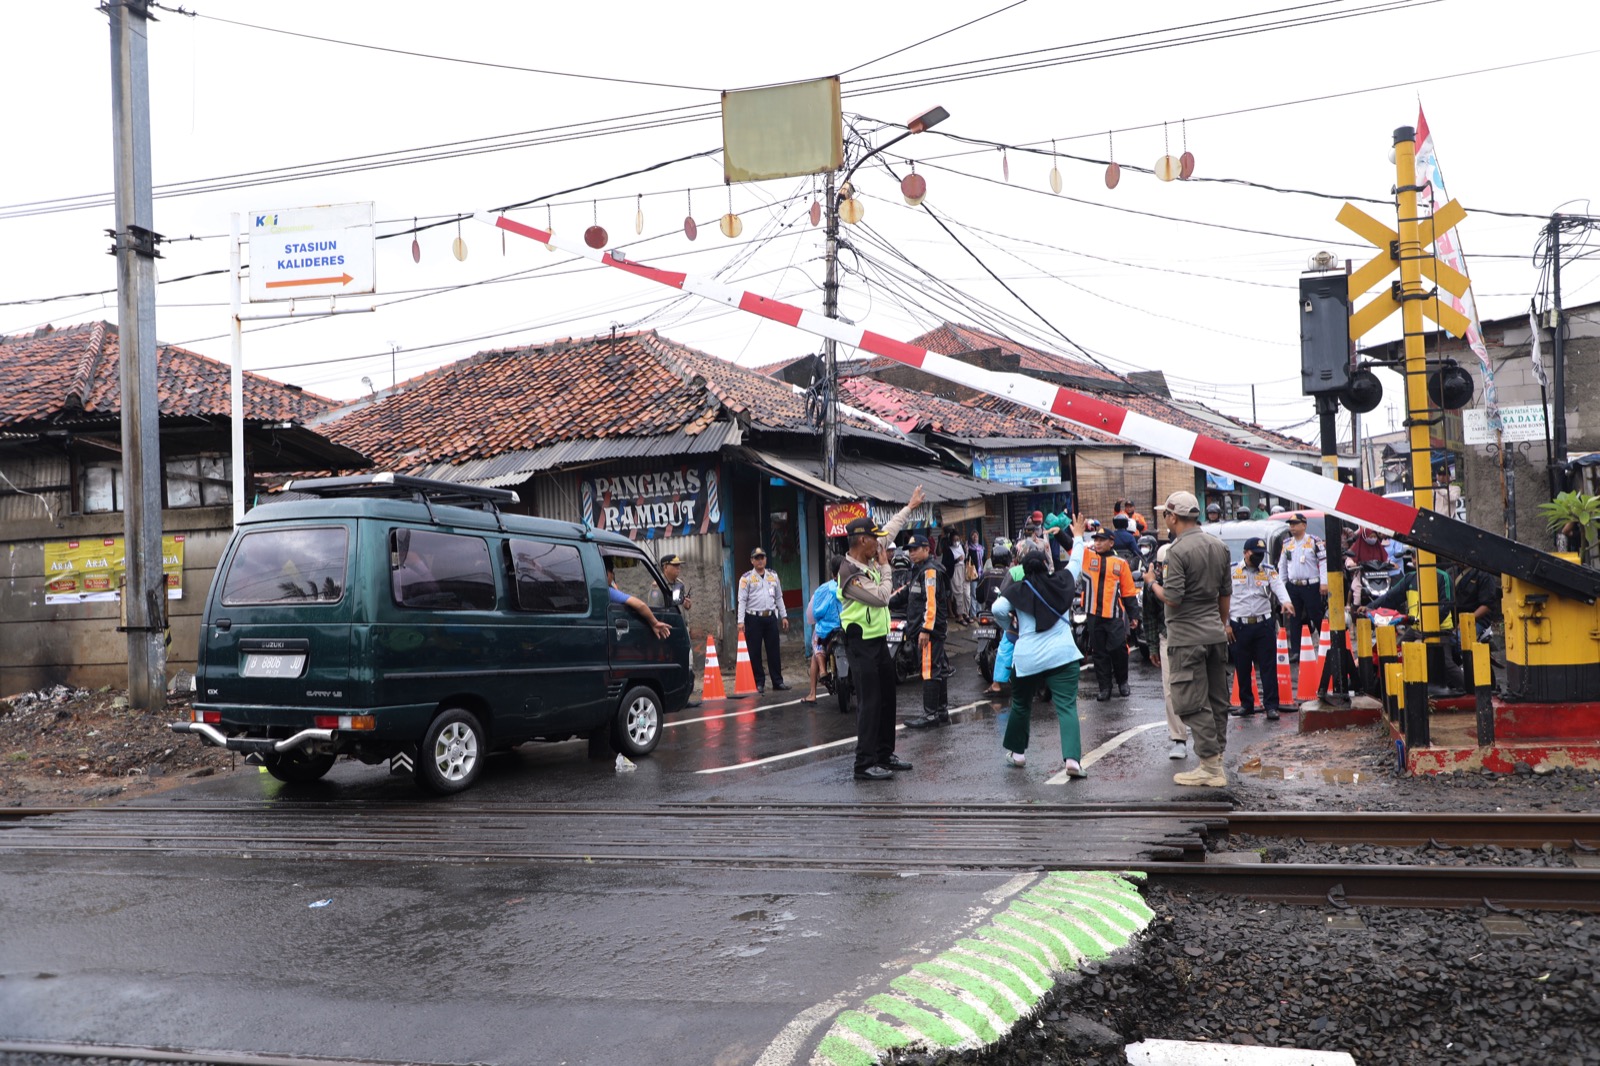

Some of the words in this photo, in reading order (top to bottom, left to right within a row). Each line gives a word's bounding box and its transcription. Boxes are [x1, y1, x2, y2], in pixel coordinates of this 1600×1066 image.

[284, 240, 337, 254] STASIUN
[277, 255, 345, 270] KALIDERES
[1517, 414, 1545, 423] DAYA
[594, 468, 701, 502] PANGKAS
[603, 499, 696, 532] RAMBUT
